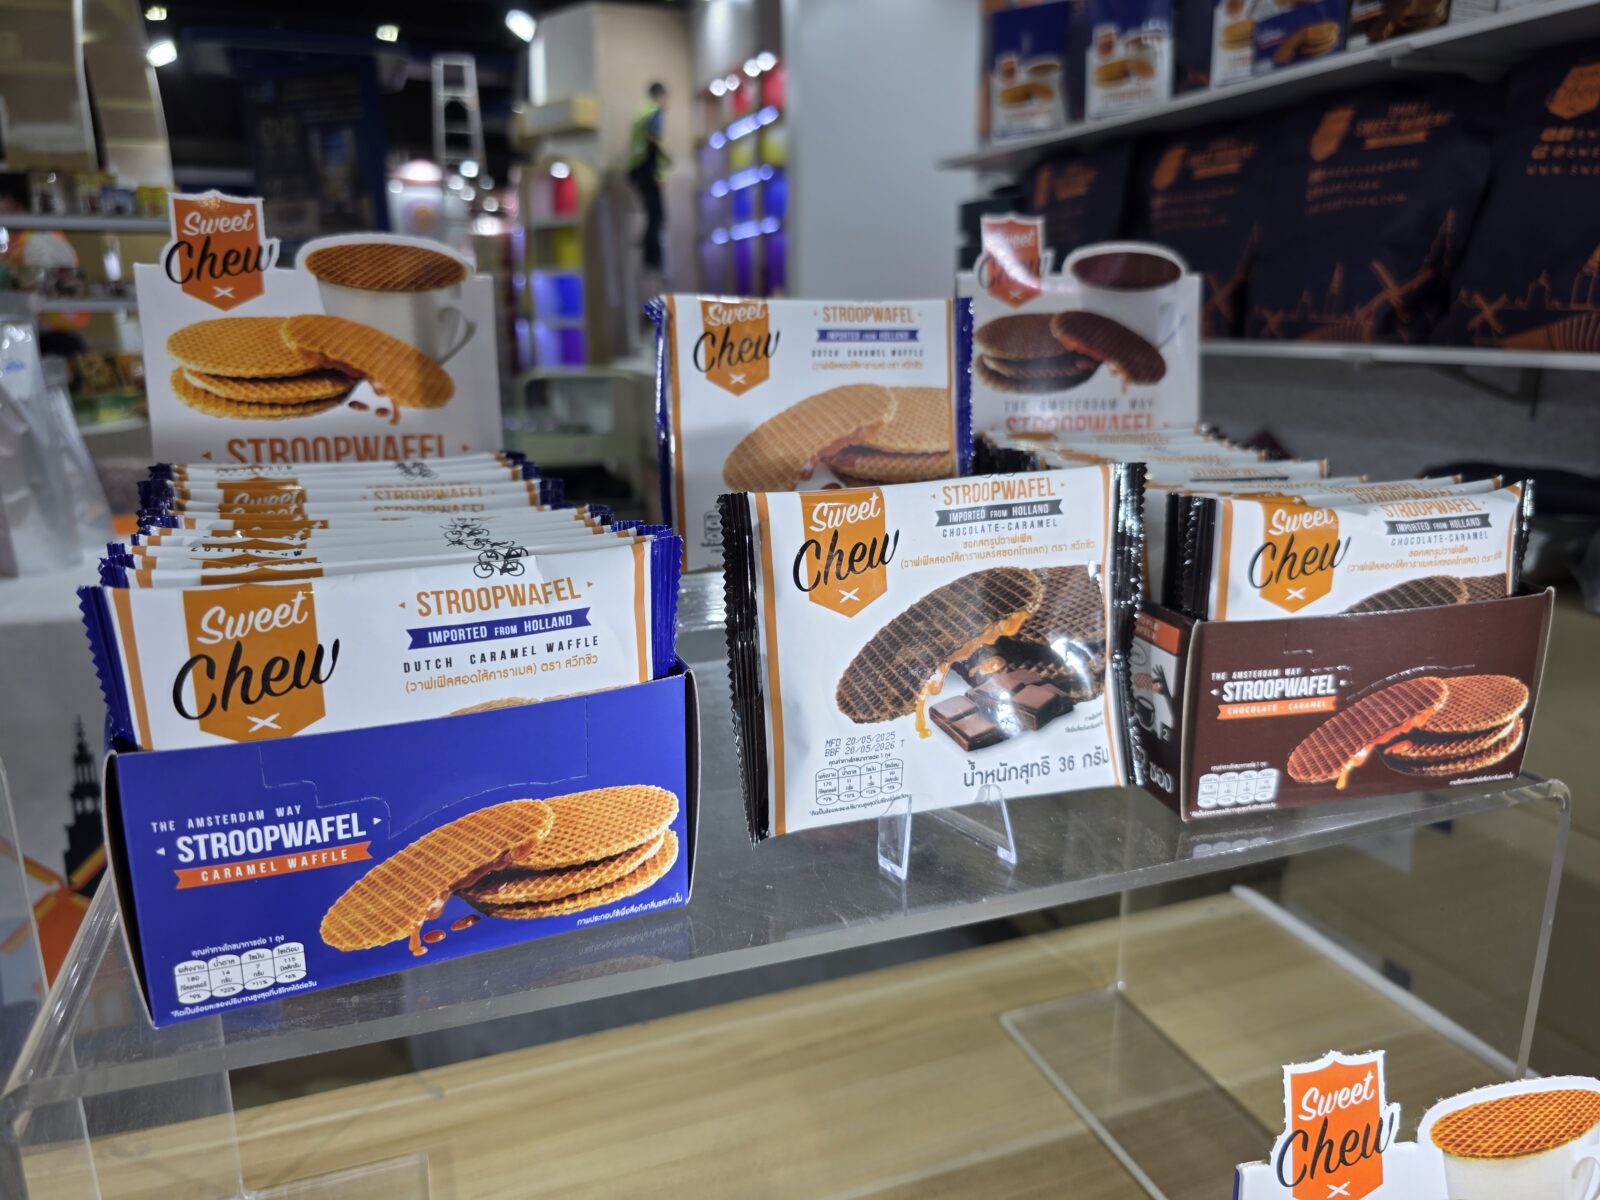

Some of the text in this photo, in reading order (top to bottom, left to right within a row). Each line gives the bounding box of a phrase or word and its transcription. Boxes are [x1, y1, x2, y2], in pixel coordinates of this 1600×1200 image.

[182, 209, 255, 236] Sweet
[165, 235, 274, 284] Chew
[705, 301, 766, 326] Sweet
[822, 305, 914, 323] STROOPWAFEL
[693, 326, 780, 373] Chew
[812, 349, 924, 358] DUTCH CARAMEL WAFFLE
[943, 477, 1056, 505] STROOPWAFEL
[809, 492, 880, 533] Sweet
[949, 504, 1049, 523] IMPORTED FROM HOLLAND
[1269, 508, 1335, 536] Sweet
[1381, 498, 1483, 518] STROOPWAFEL
[942, 518, 1058, 538] CHOCOLATE-CARAMEL
[1391, 531, 1488, 546] CHOCOLATE-CARAMEL
[1395, 517, 1481, 533] IMPORTED FROM HOLLAND
[792, 529, 900, 592] Chew
[1248, 534, 1351, 589] Chew
[416, 577, 581, 617] STROOPWAFEL
[197, 591, 308, 645] Sweet
[428, 614, 572, 644] IMPORTED FROM HOLLAND
[404, 635, 599, 673] DUTCH CARAMEL WAFFLE
[173, 638, 340, 720] Chew
[1211, 667, 1302, 681] THE AMSTERDAM WAY
[1222, 674, 1337, 702] STROOPWAFEL
[1227, 701, 1327, 715] CHOCOLATE CARAMEL
[825, 731, 895, 748] MFD 20/05/2025
[825, 747, 840, 757] BBF
[845, 741, 895, 755] 20/05/2026
[964, 745, 1109, 787] น้ำหนักสุทธิ 36 กรัม
[152, 804, 302, 833] THE AMSTERDAM WAY
[176, 812, 367, 863] STROOPWAFEL
[201, 848, 348, 882] CARAMEL WAFFLE
[1298, 1070, 1375, 1121] Sweet
[1276, 1110, 1394, 1188] Chew
